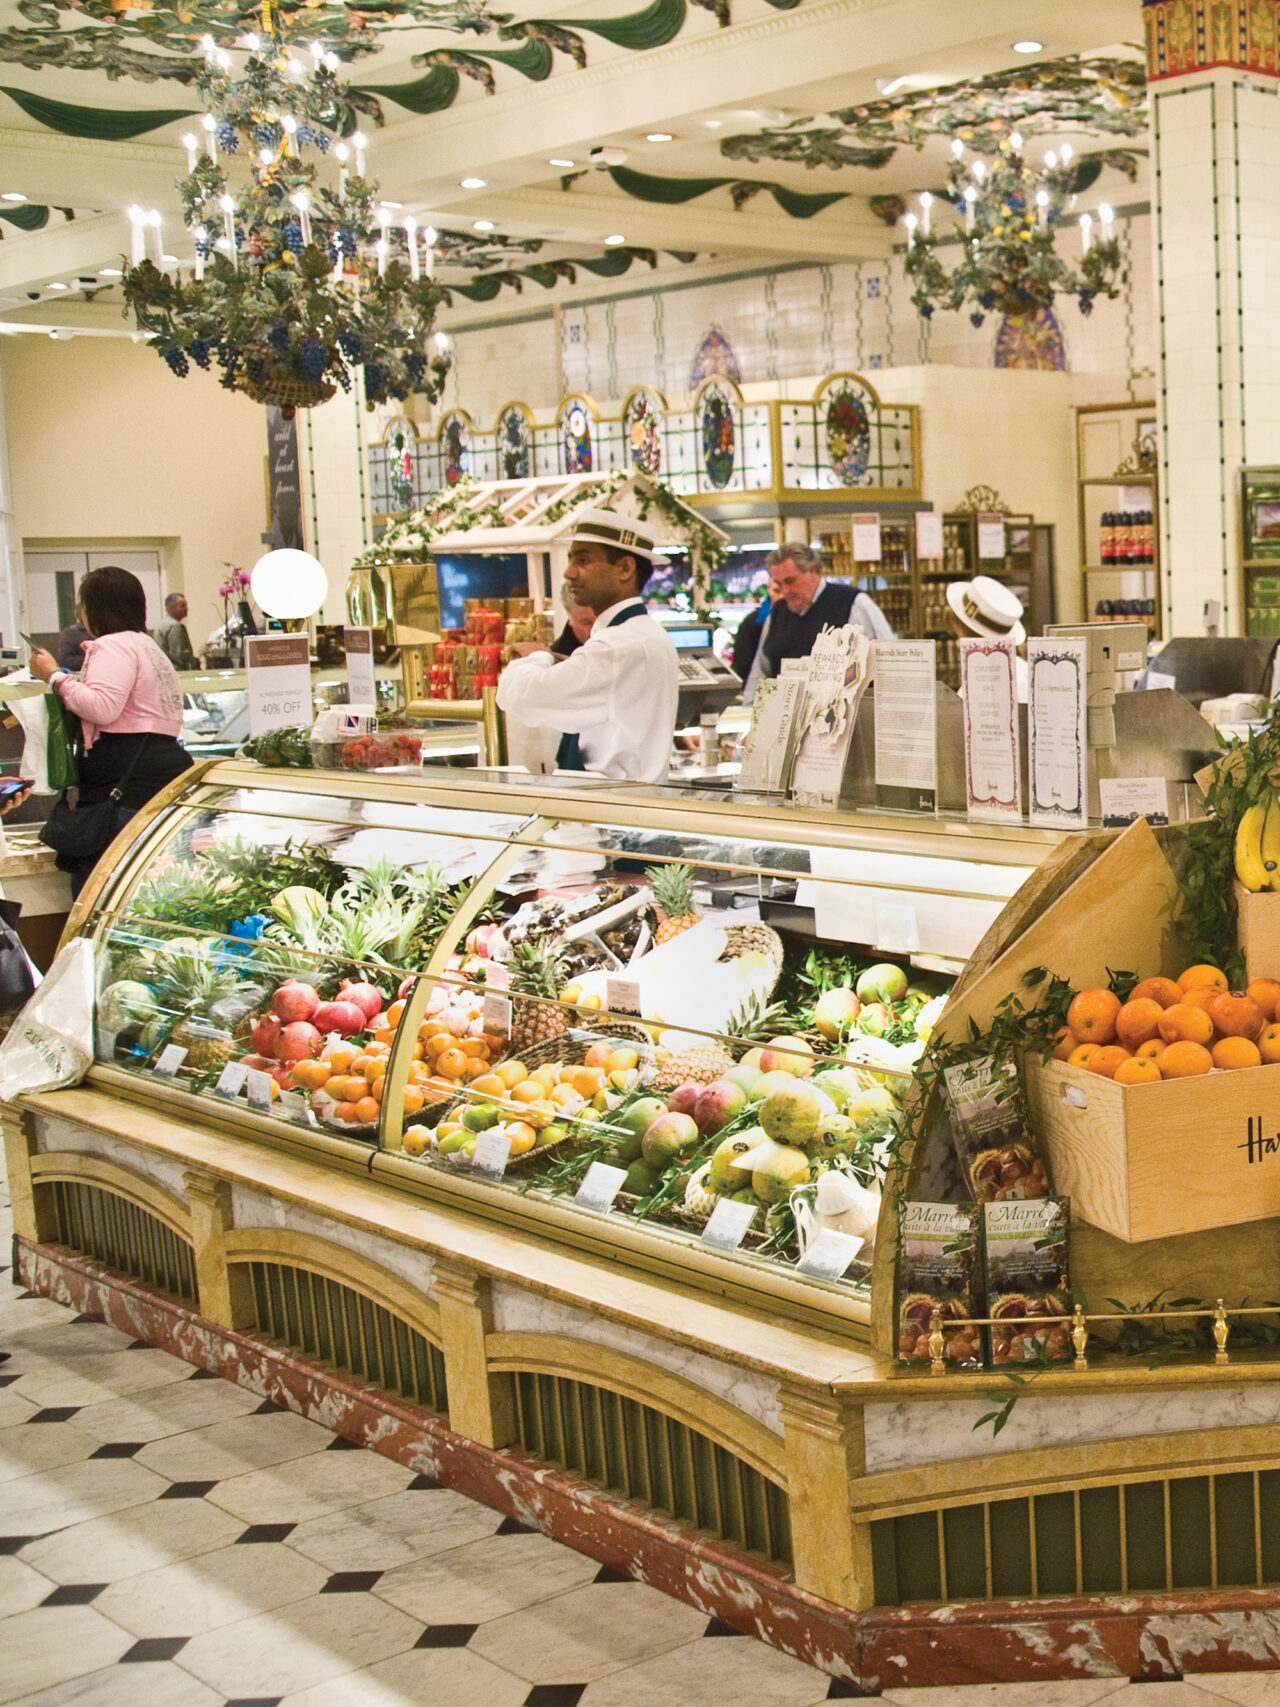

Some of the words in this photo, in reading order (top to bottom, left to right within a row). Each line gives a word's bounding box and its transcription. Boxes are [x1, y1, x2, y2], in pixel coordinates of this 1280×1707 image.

[784, 682, 797, 713] Store
[262, 703, 281, 715] 40%
[283, 702, 302, 714] OFF
[776, 713, 792, 747] Guide
[933, 1222, 943, 1233] la
[988, 1221, 1011, 1232] cuits
[1022, 1220, 1032, 1230] la
